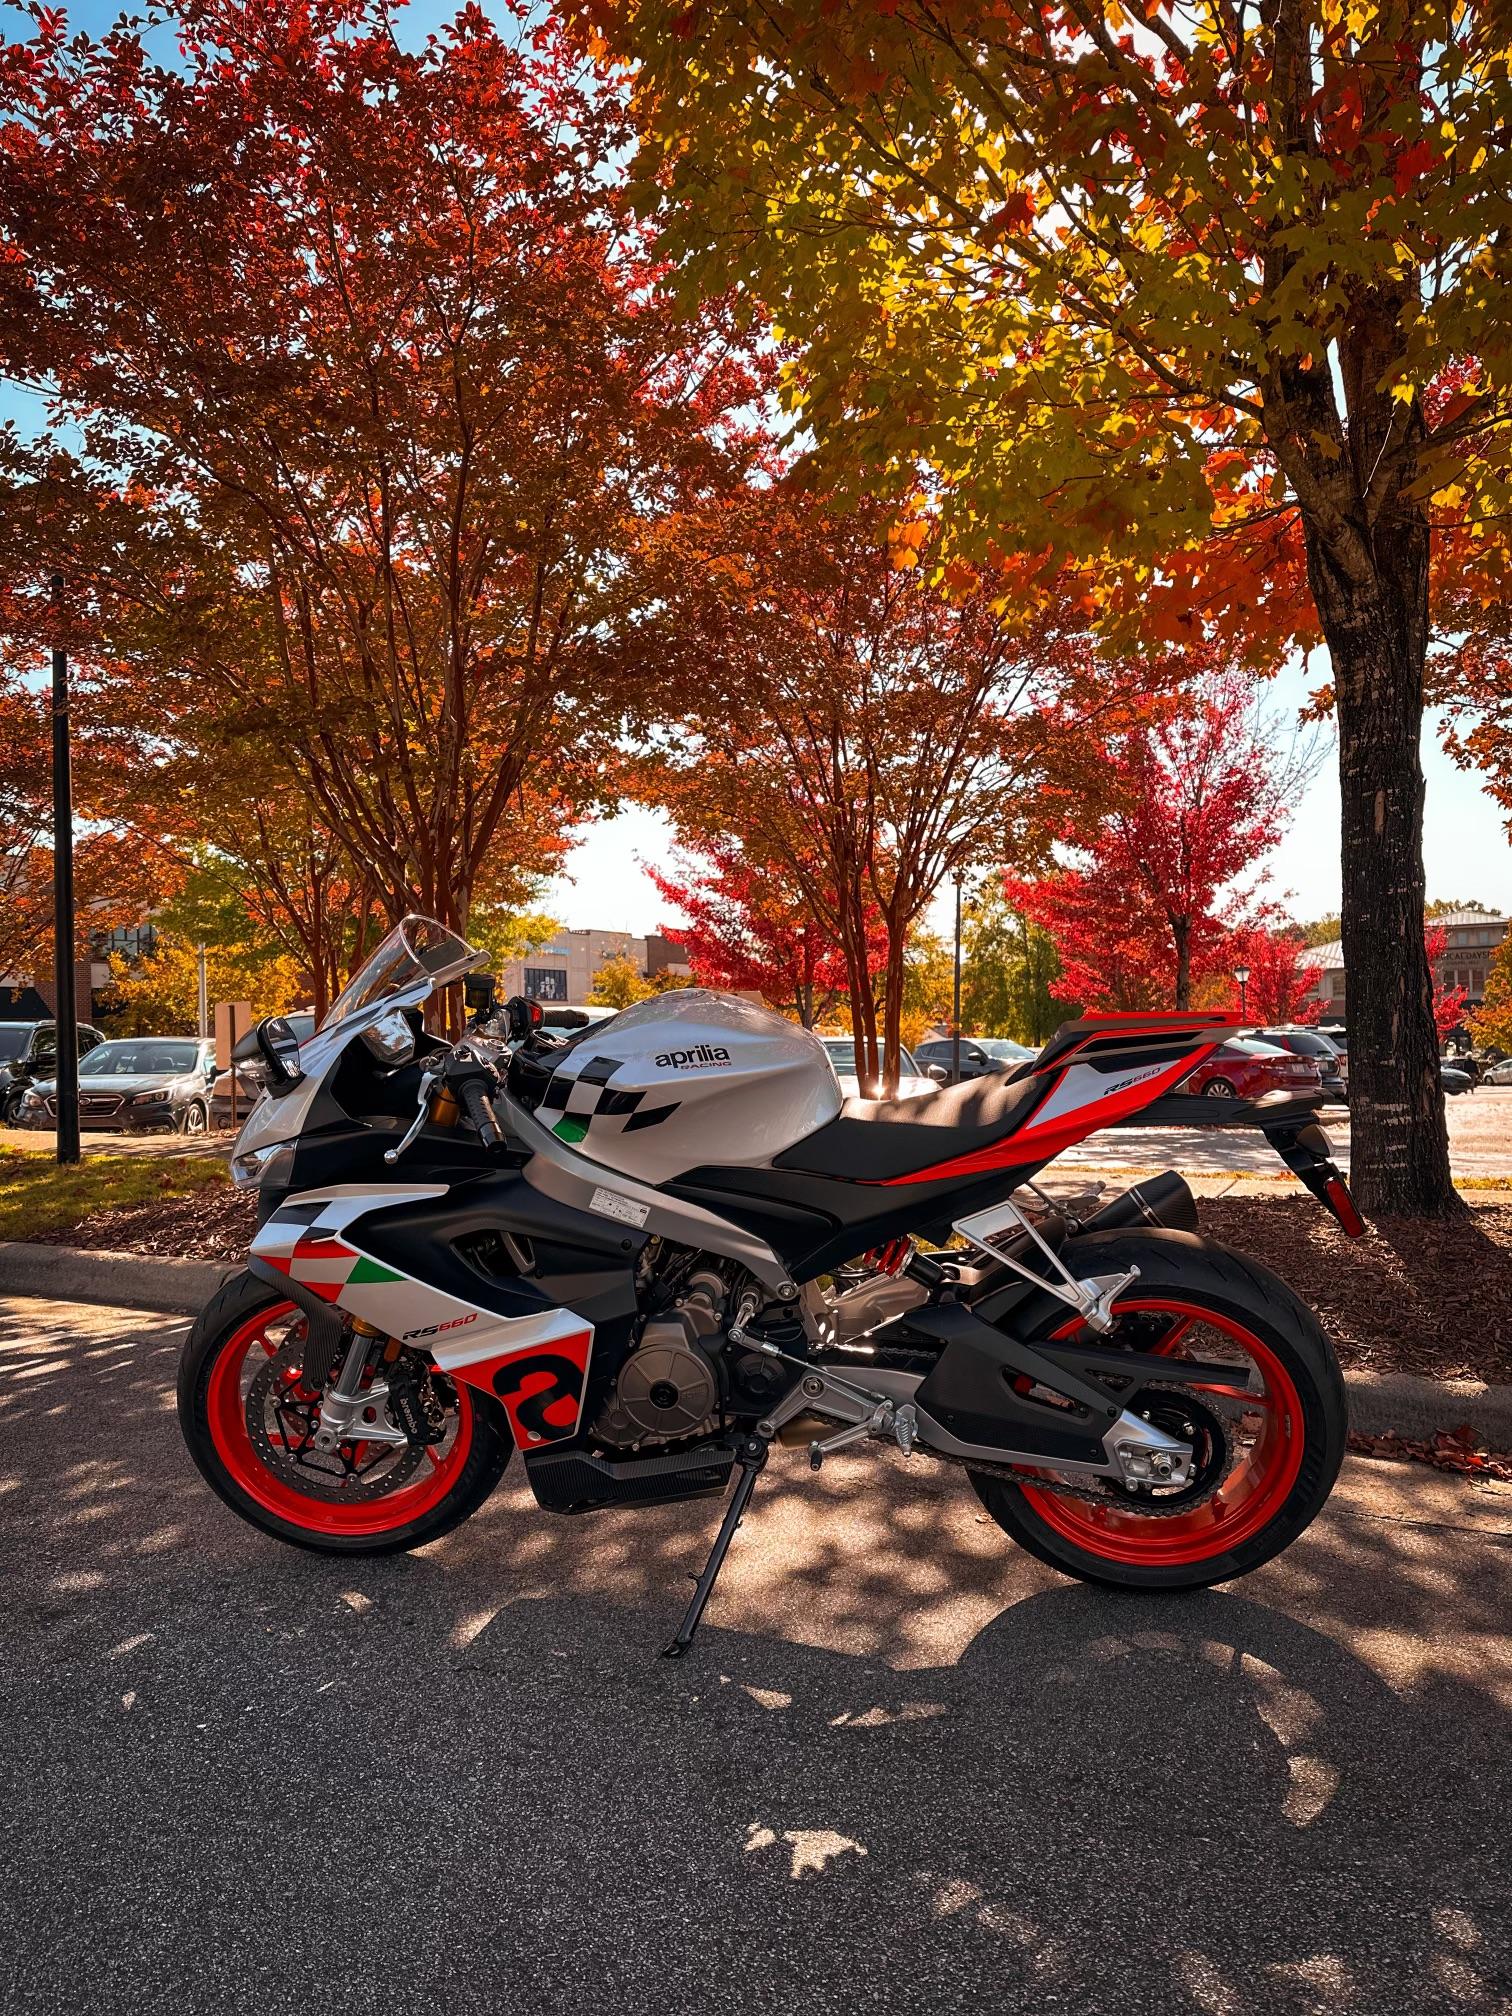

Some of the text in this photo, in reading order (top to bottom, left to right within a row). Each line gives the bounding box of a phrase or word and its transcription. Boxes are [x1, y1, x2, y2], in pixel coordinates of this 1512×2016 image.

[655, 1045, 730, 1068] aprilia
[681, 1061, 732, 1070] RACING
[1104, 1067, 1161, 1096] RS660
[403, 1313, 478, 1340] RS660
[400, 1398, 418, 1434] brembo
